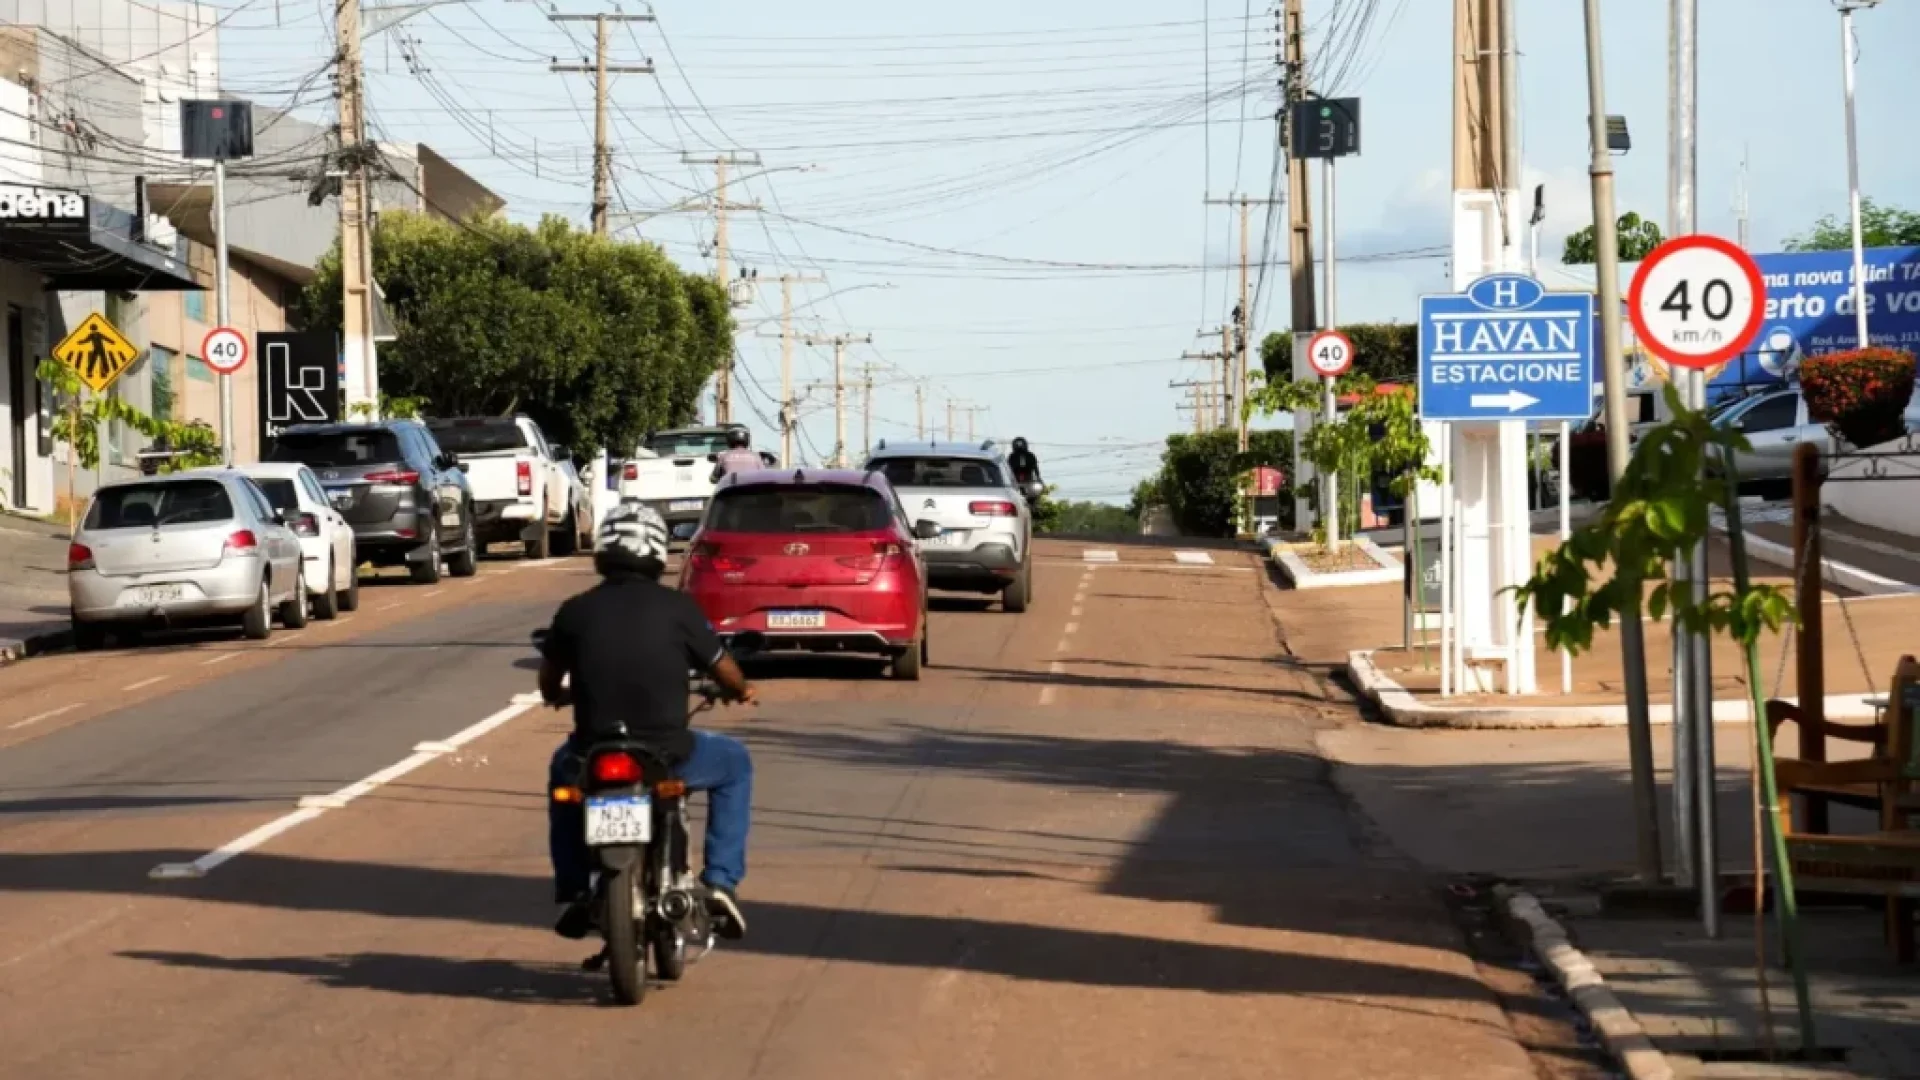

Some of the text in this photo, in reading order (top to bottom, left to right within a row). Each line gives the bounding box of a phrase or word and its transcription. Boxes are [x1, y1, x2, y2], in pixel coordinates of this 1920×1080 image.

[1794, 269, 1843, 286] nova
[1492, 280, 1520, 307] H
[1660, 278, 1733, 322] 40
[1763, 292, 1826, 319] erto
[1432, 319, 1579, 352] HAVAN
[1672, 327, 1723, 343] km/h
[212, 342, 238, 357] 40
[1318, 345, 1343, 361] 40
[1431, 363, 1582, 383] ESTACIONE
